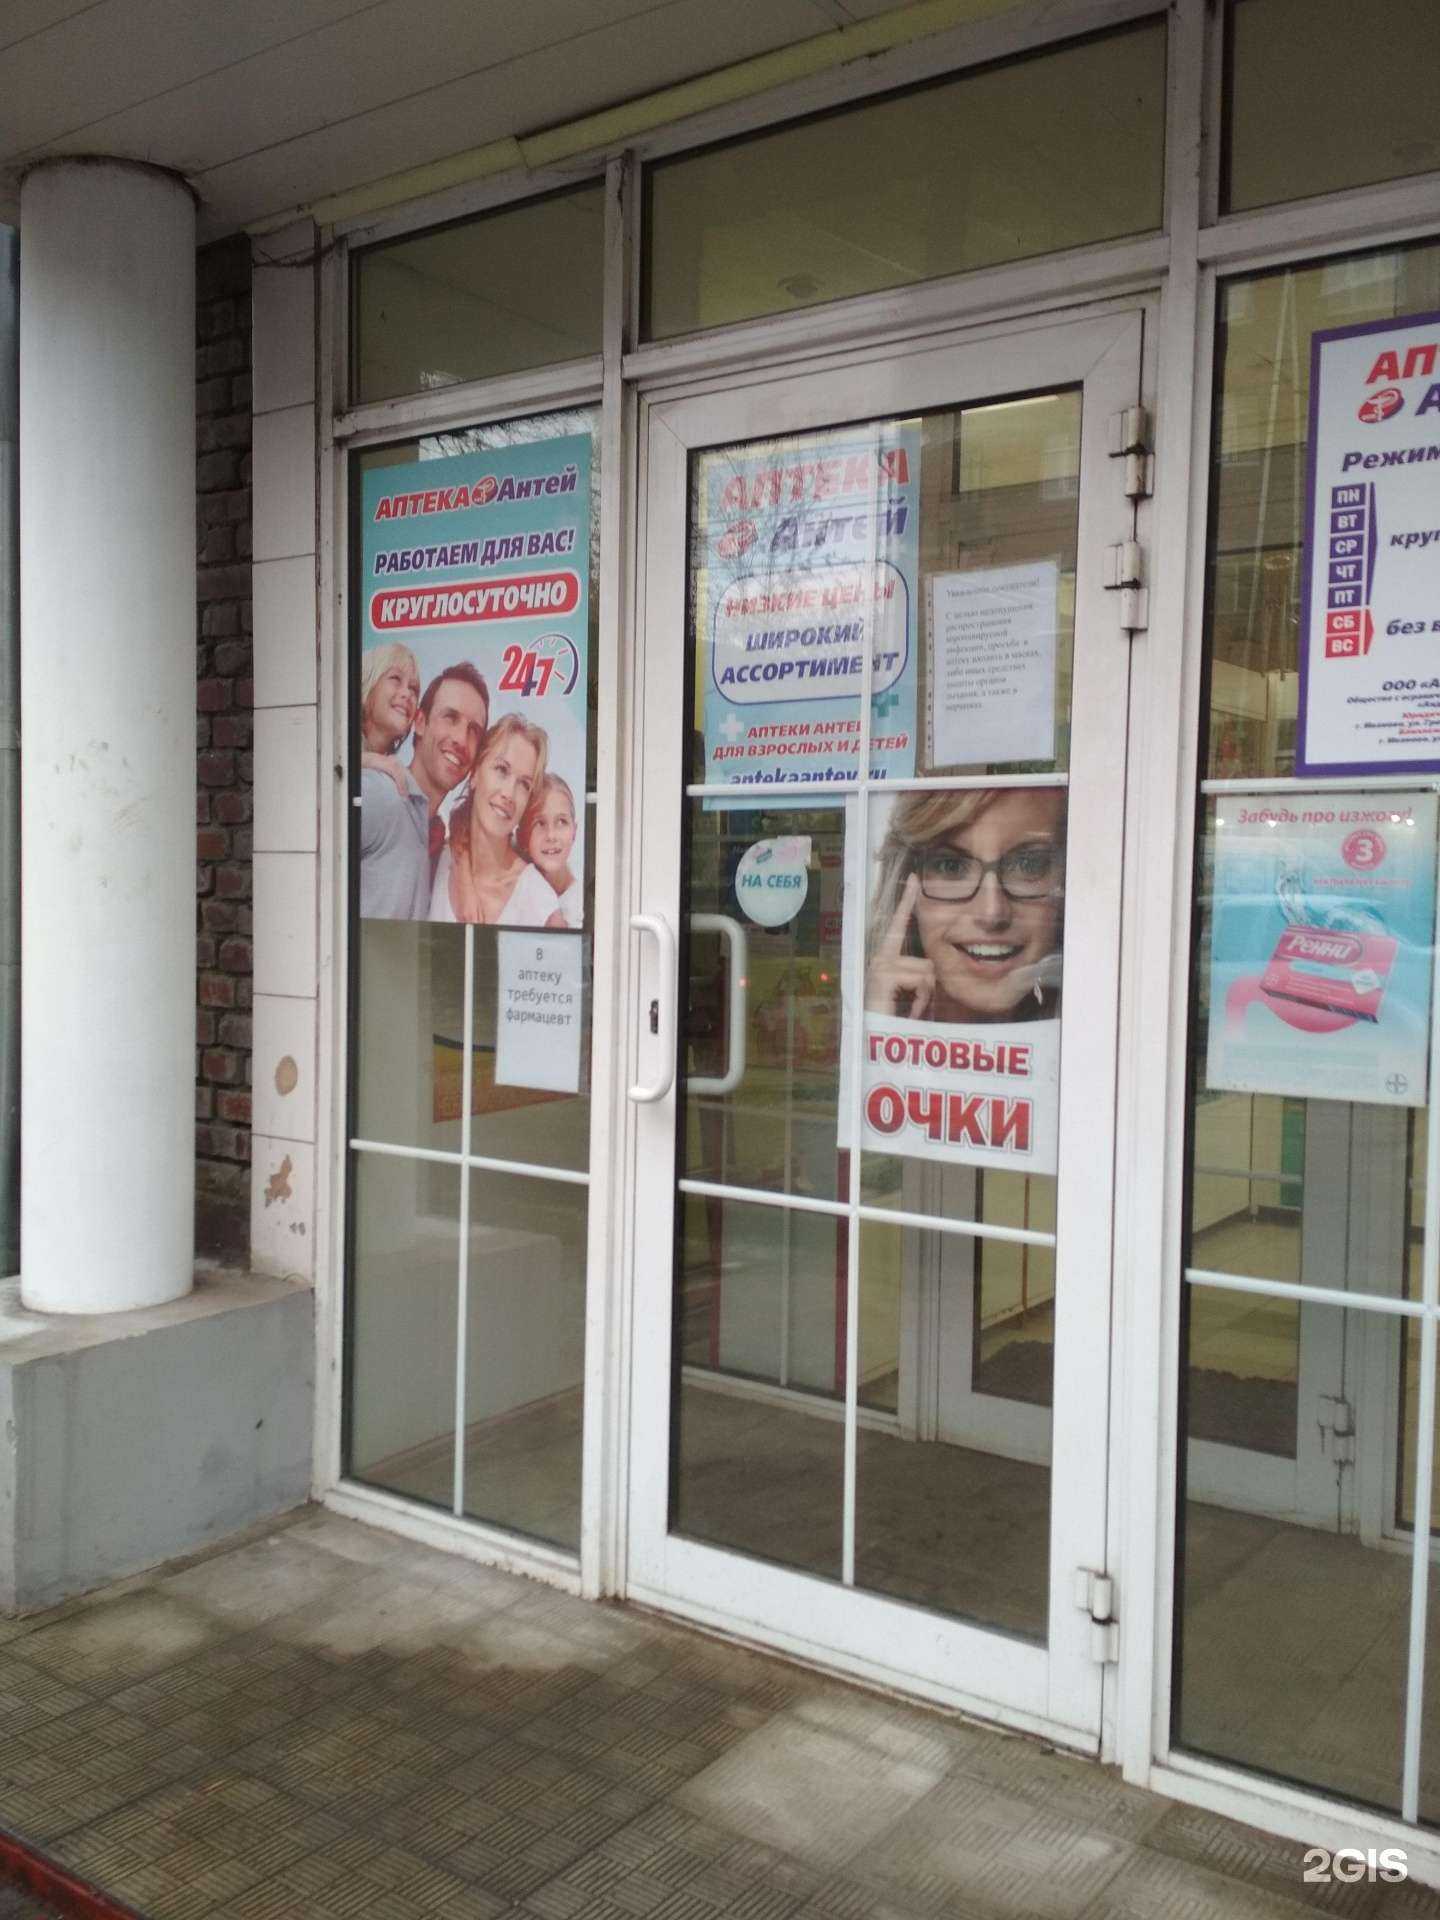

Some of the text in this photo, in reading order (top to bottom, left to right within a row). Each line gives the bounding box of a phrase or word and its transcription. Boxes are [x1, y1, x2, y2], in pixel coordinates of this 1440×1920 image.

[1342, 446, 1440, 472] Режим
[720, 448, 909, 513] АПТЕКА
[374, 465, 577, 520] АПТЕКА Антей
[1337, 488, 1360, 504] ПН
[1337, 514, 1358, 529] ВТ
[375, 529, 575, 574] РАБОТАЕМ ДЛЯ ВАС!
[1335, 538, 1358, 554] СР
[1335, 564, 1356, 579] ЧТ
[380, 580, 568, 622] КРУГЛОСУТОЧНО
[1334, 589, 1355, 604] ПТ
[1332, 615, 1355, 630] СБ
[1386, 619, 1426, 636] без
[1332, 638, 1354, 654] ВС
[1382, 679, 1416, 691] ООО
[748, 723, 810, 738] АПТЕКИ
[714, 744, 745, 761] ДЛЯ
[748, 740, 833, 757] ВЗРОСЛЫХ
[837, 739, 850, 753] И
[1237, 808, 1298, 825] Забудь
[1302, 811, 1336, 827] про
[1355, 838, 1375, 862] 3
[742, 873, 802, 890] НА СЕБЯ
[1287, 934, 1352, 960] Ренни
[517, 968, 563, 987] аптеку
[507, 987, 574, 1006] требуется
[505, 1007, 573, 1026] фармацевт
[868, 1034, 1030, 1077] ГОТОВЫЕ
[866, 1085, 1032, 1152] ОЧКИ
